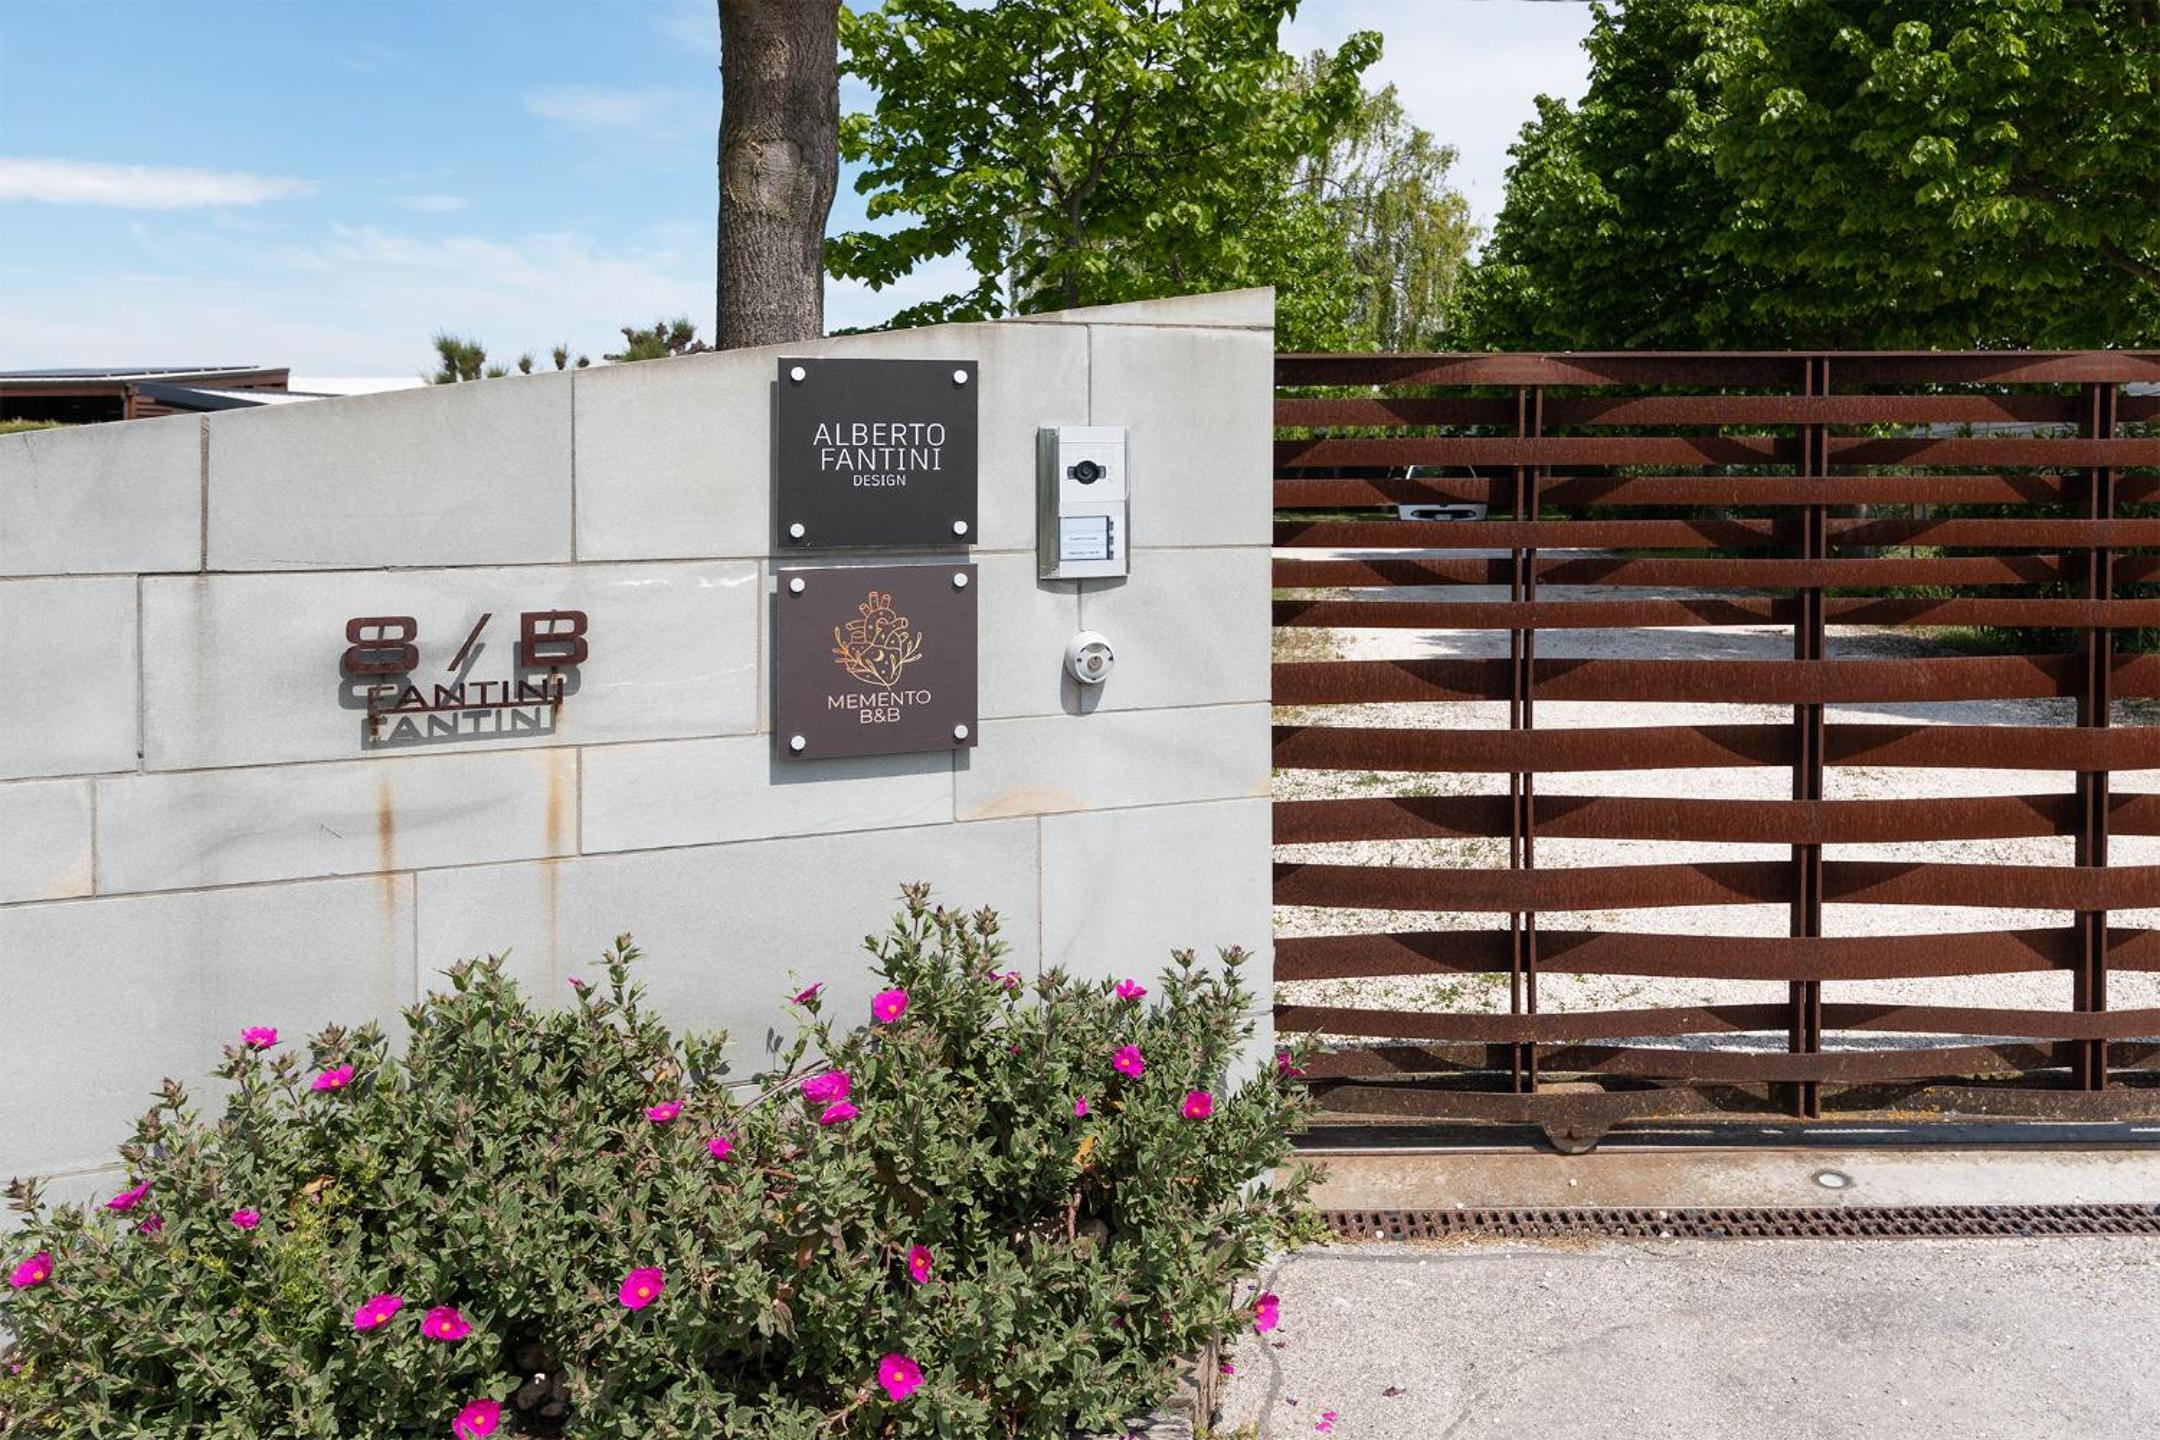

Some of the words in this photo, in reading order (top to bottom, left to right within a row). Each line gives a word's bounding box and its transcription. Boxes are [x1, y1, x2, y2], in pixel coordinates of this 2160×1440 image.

[813, 423, 945, 446] ALBERTO
[821, 448, 941, 471] FANTINI
[853, 474, 906, 486] DESIGN
[827, 690, 931, 710] MEMENTO
[860, 707, 901, 724] B&B
